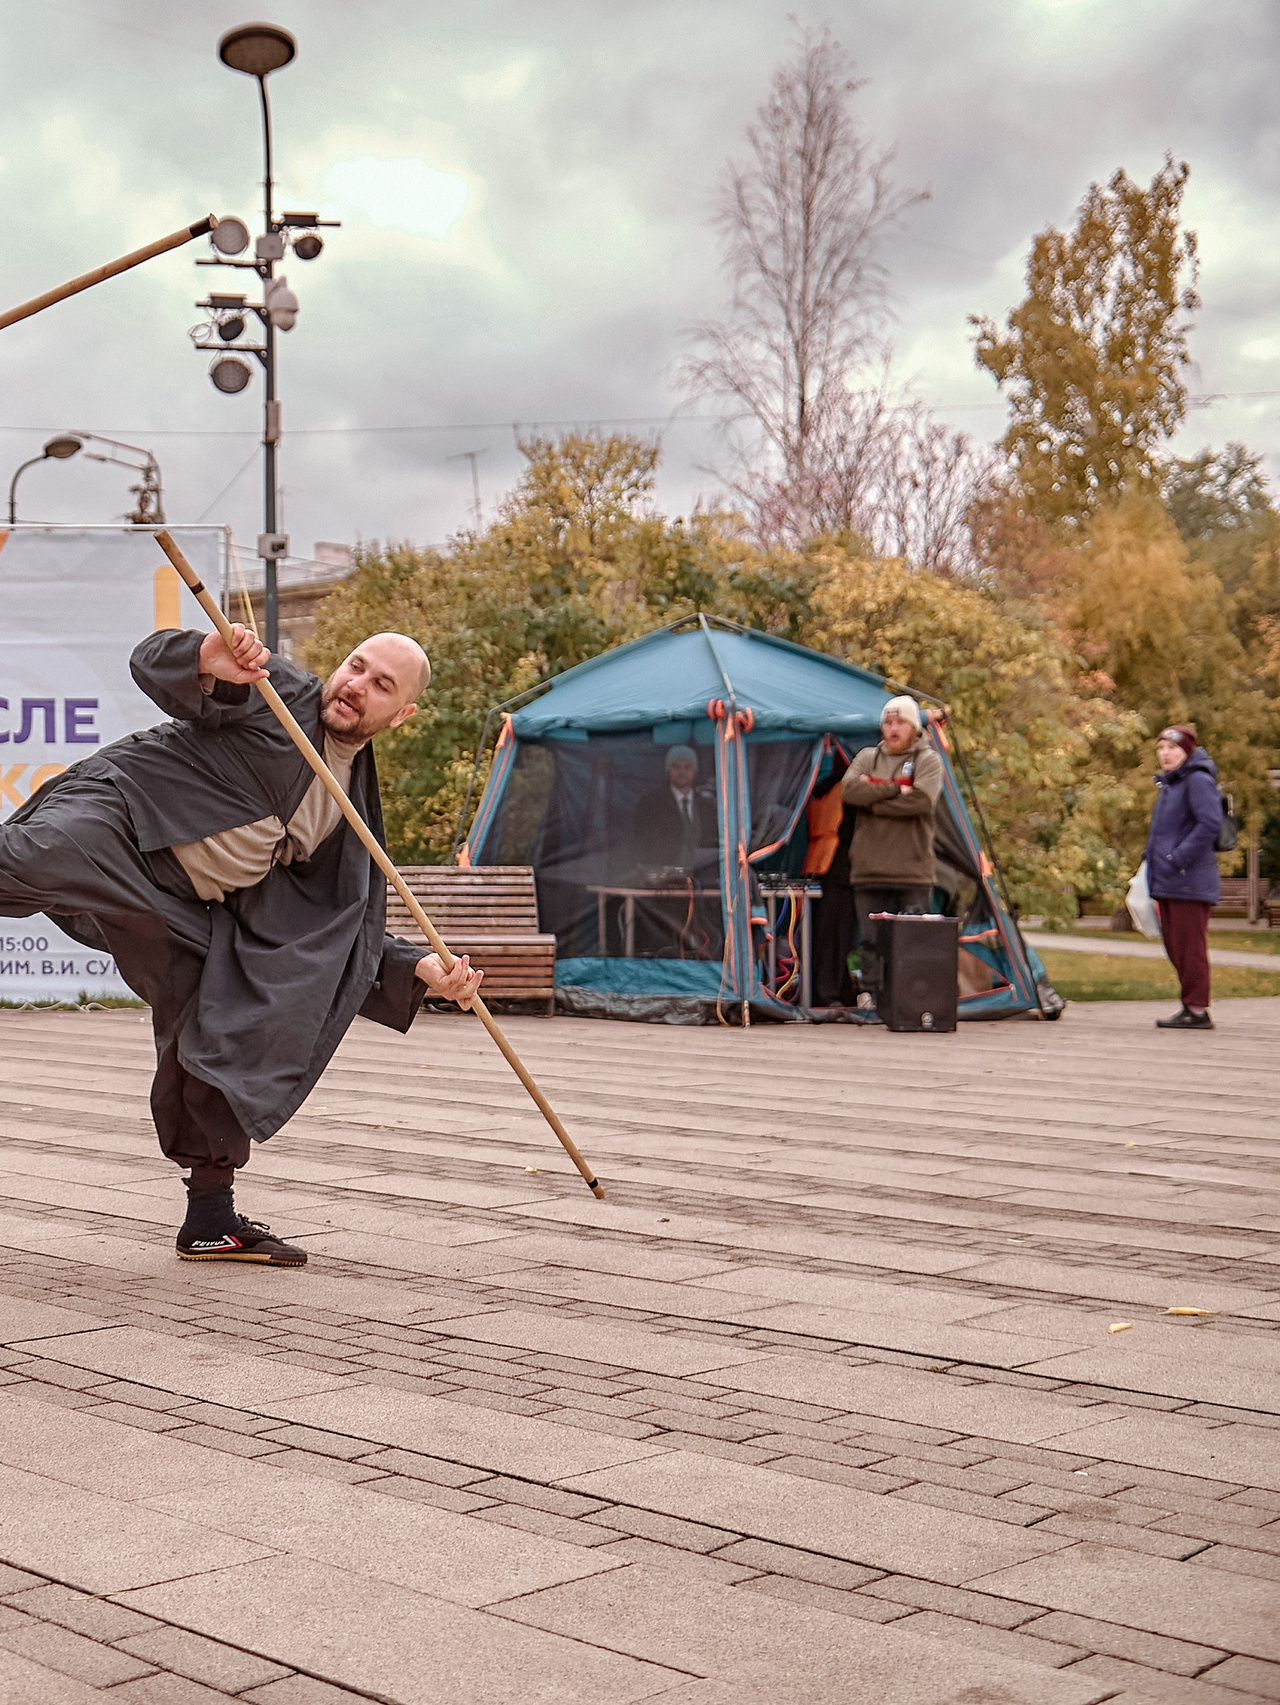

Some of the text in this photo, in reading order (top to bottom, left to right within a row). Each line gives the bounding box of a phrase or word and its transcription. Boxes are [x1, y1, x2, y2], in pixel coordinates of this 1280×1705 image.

[0, 960, 35, 975] ИМ.
[42, 960, 80, 975] В.И.
[191, 1239, 226, 1247] FEIYUE
